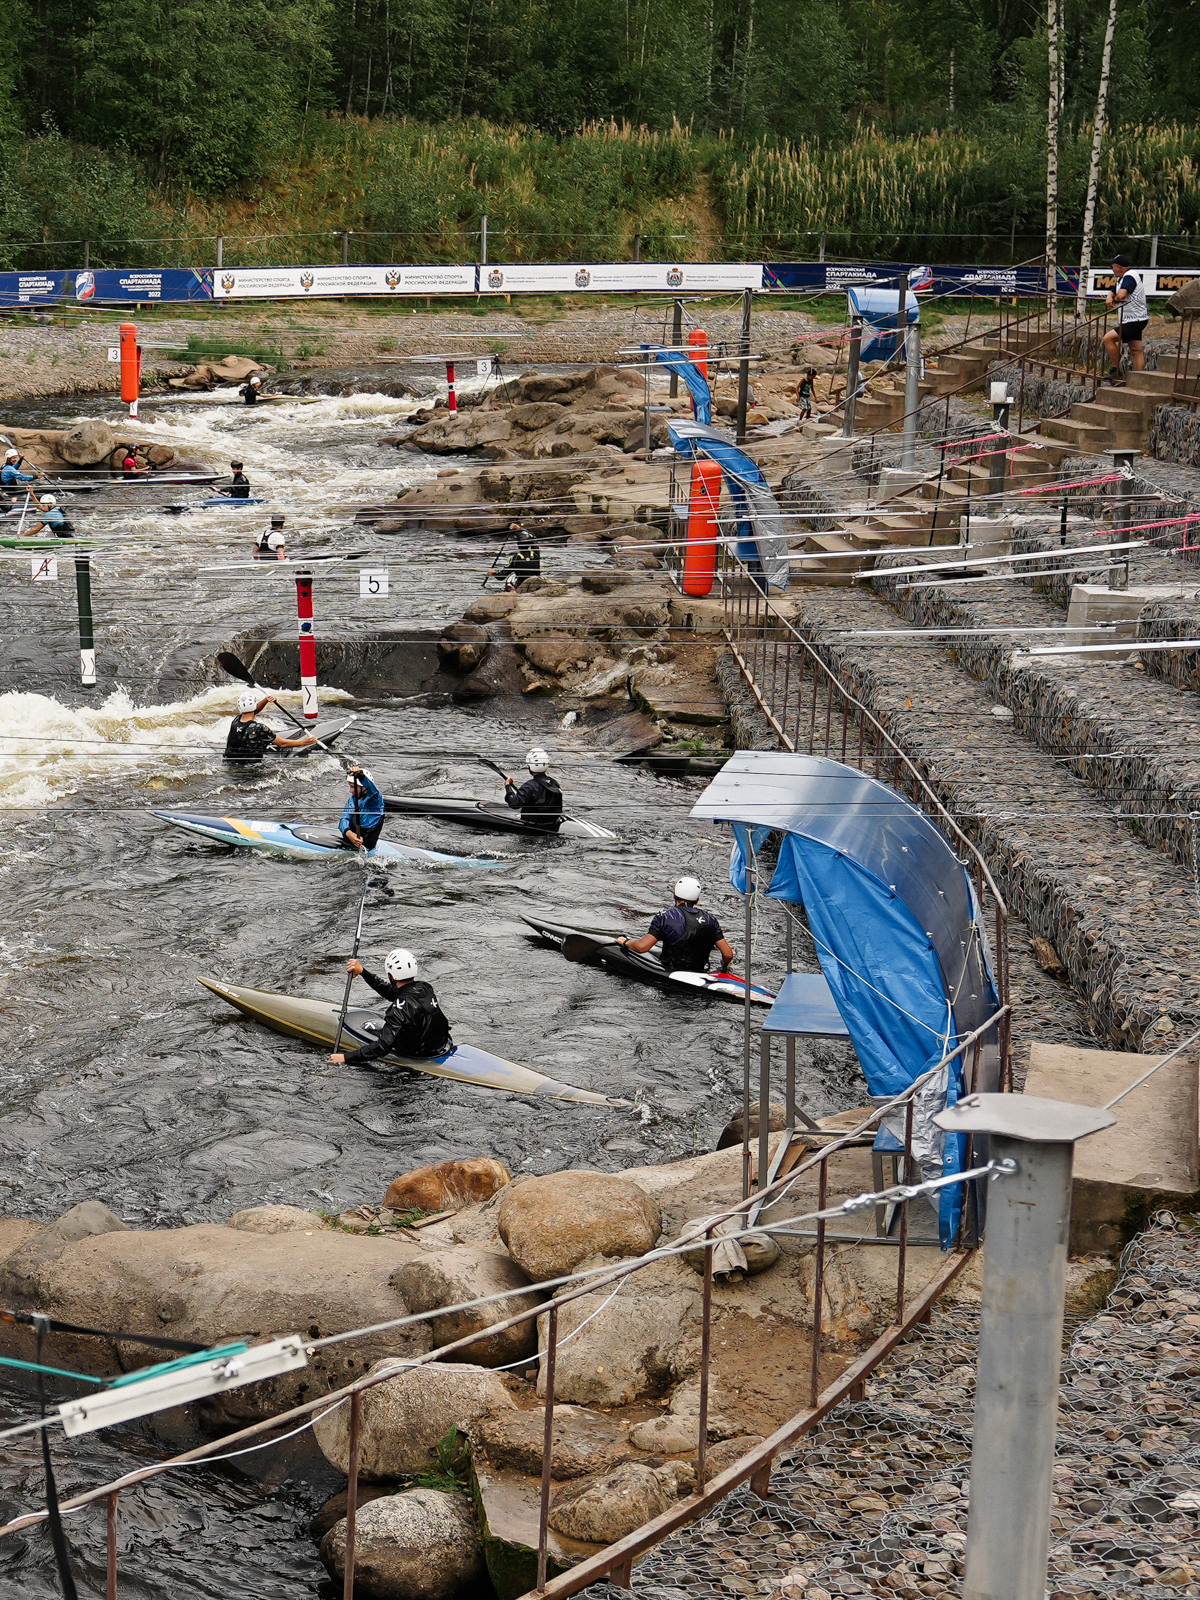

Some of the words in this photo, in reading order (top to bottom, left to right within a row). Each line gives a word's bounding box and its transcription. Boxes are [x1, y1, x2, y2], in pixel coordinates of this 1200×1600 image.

[112, 350, 118, 359] 3
[481, 362, 487, 372] 3
[40, 559, 50, 576] 4
[368, 576, 380, 594] 5
[542, 930, 565, 944] CONNEC
